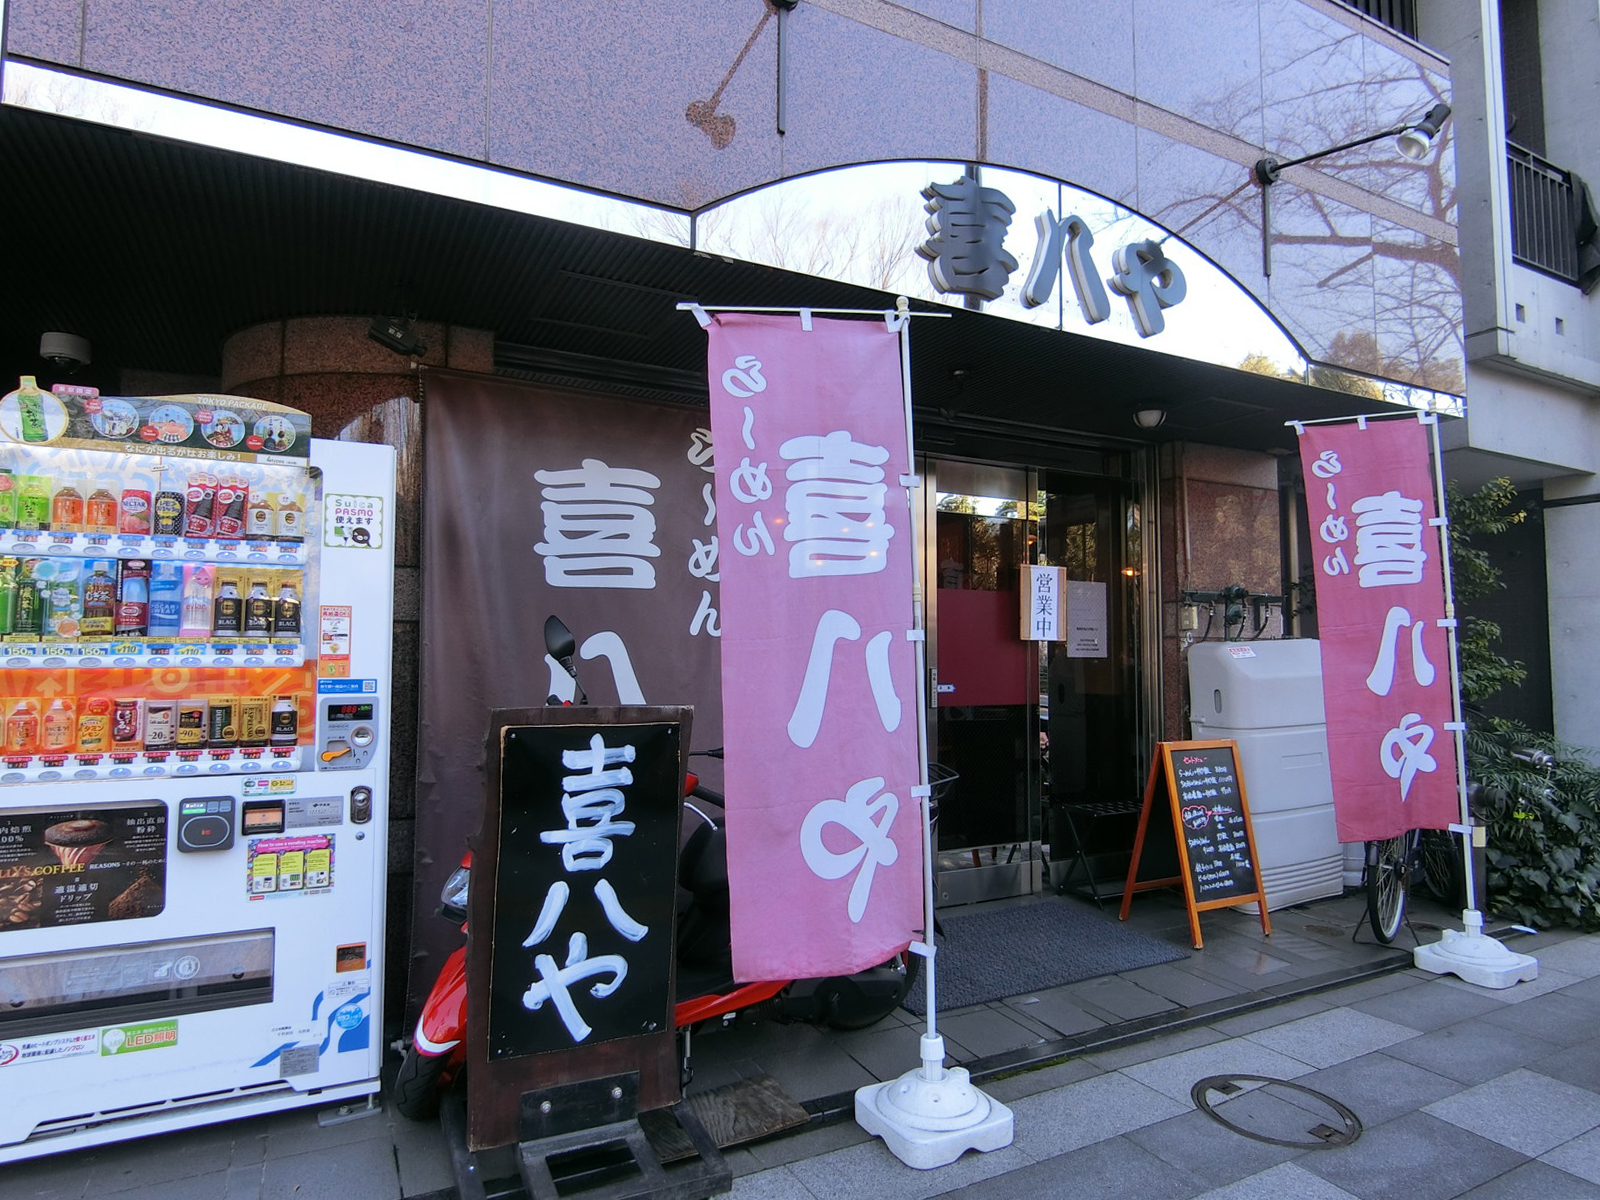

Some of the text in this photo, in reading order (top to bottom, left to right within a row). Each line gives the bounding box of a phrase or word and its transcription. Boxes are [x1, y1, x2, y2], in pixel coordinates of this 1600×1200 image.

[914, 176, 1187, 339] 喜八や
[196, 396, 268, 411] TOKYO PACKAGE
[335, 500, 373, 508] Suica
[335, 508, 373, 517] PASMO
[335, 516, 373, 526] 使えます
[1036, 573, 1053, 637] 営業中
[34, 862, 85, 876] COFFEE
[89, 861, 120, 870] REASONS
[522, 733, 648, 1043] 喜八や
[125, 1031, 176, 1048] LED照明
